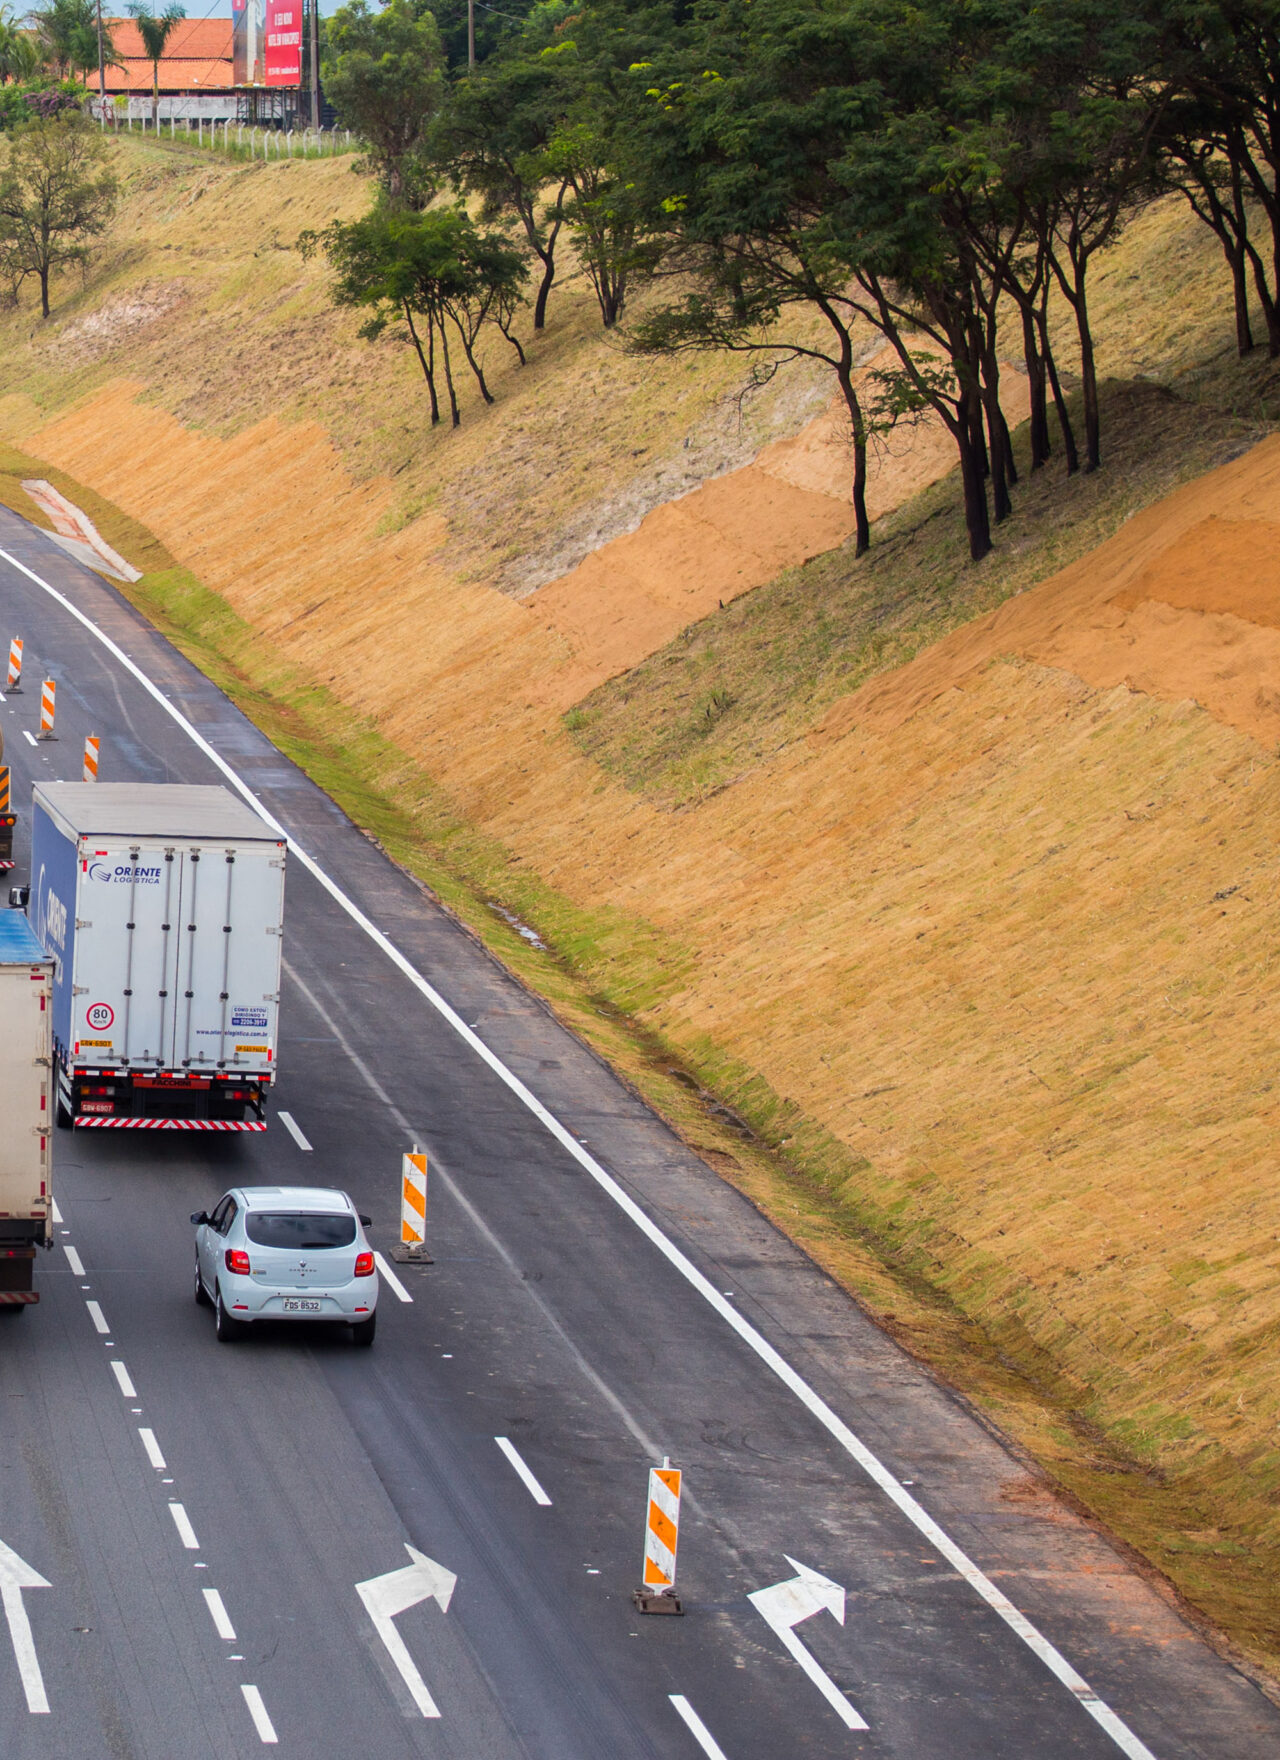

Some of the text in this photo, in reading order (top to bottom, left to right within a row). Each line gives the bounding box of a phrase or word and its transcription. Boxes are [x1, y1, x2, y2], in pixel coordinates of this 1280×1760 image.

[113, 877, 160, 885] LOGSTICA
[93, 1008, 108, 1019] 80
[151, 1079, 192, 1087] FACCHINI
